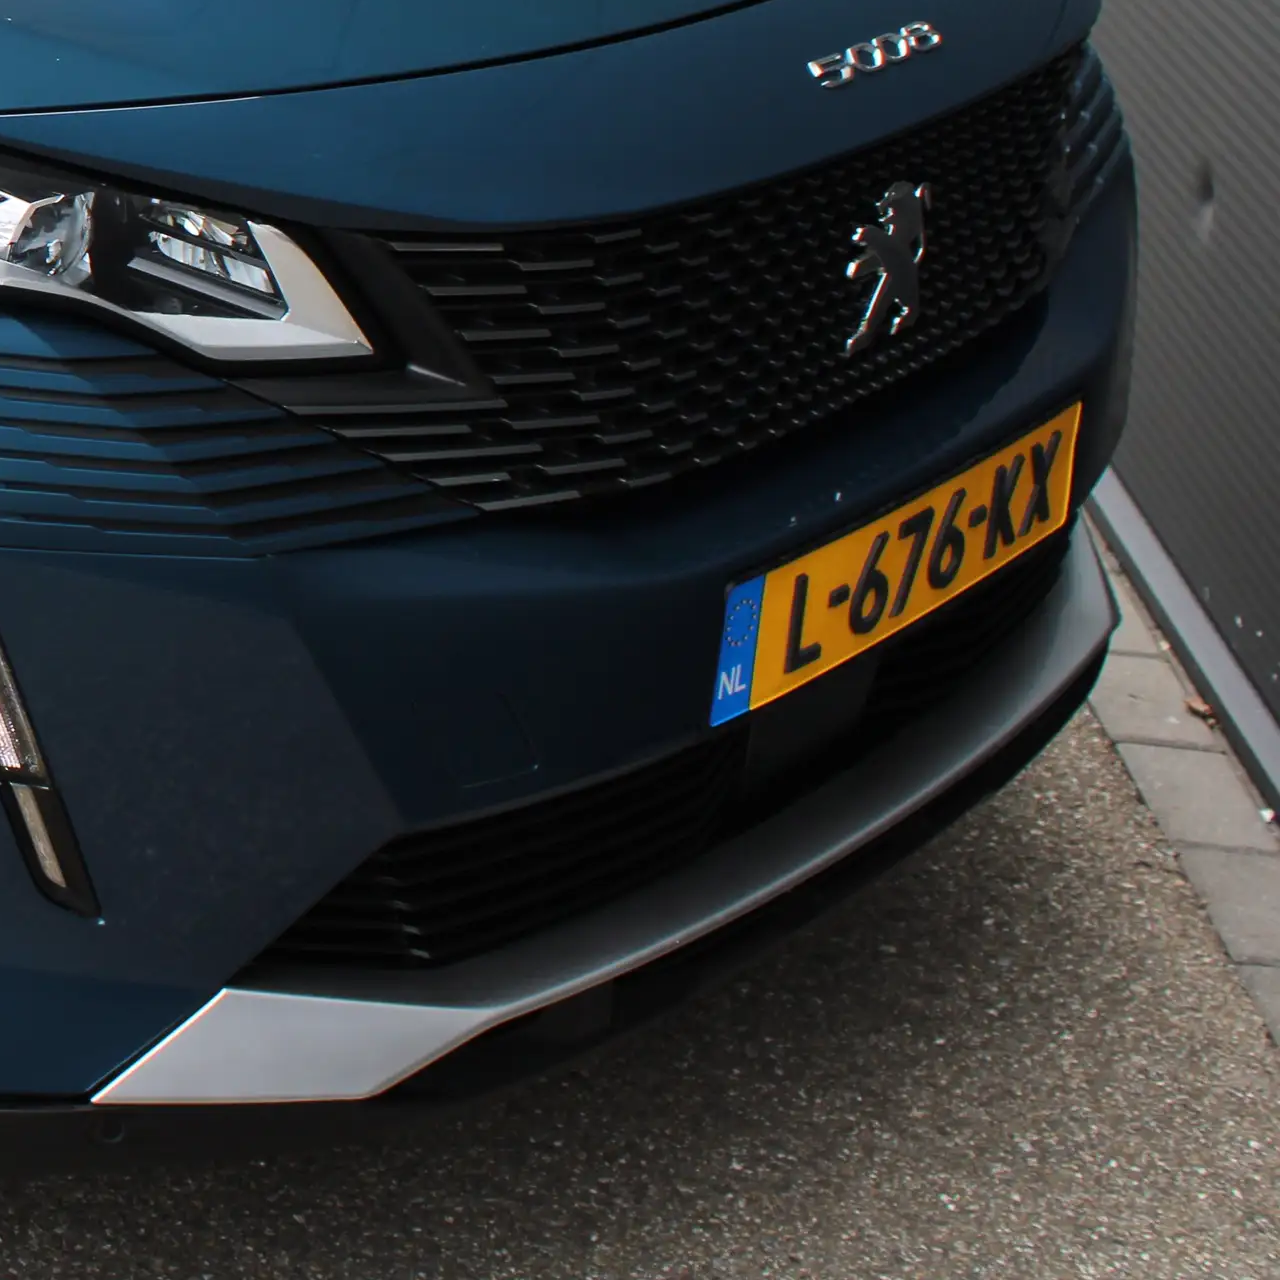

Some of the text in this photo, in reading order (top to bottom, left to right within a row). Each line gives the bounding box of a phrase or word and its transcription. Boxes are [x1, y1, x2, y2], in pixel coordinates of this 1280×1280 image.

[806, 21, 942, 88] 5008
[783, 429, 1063, 675] L-676-KX
[717, 664, 747, 700] NL
